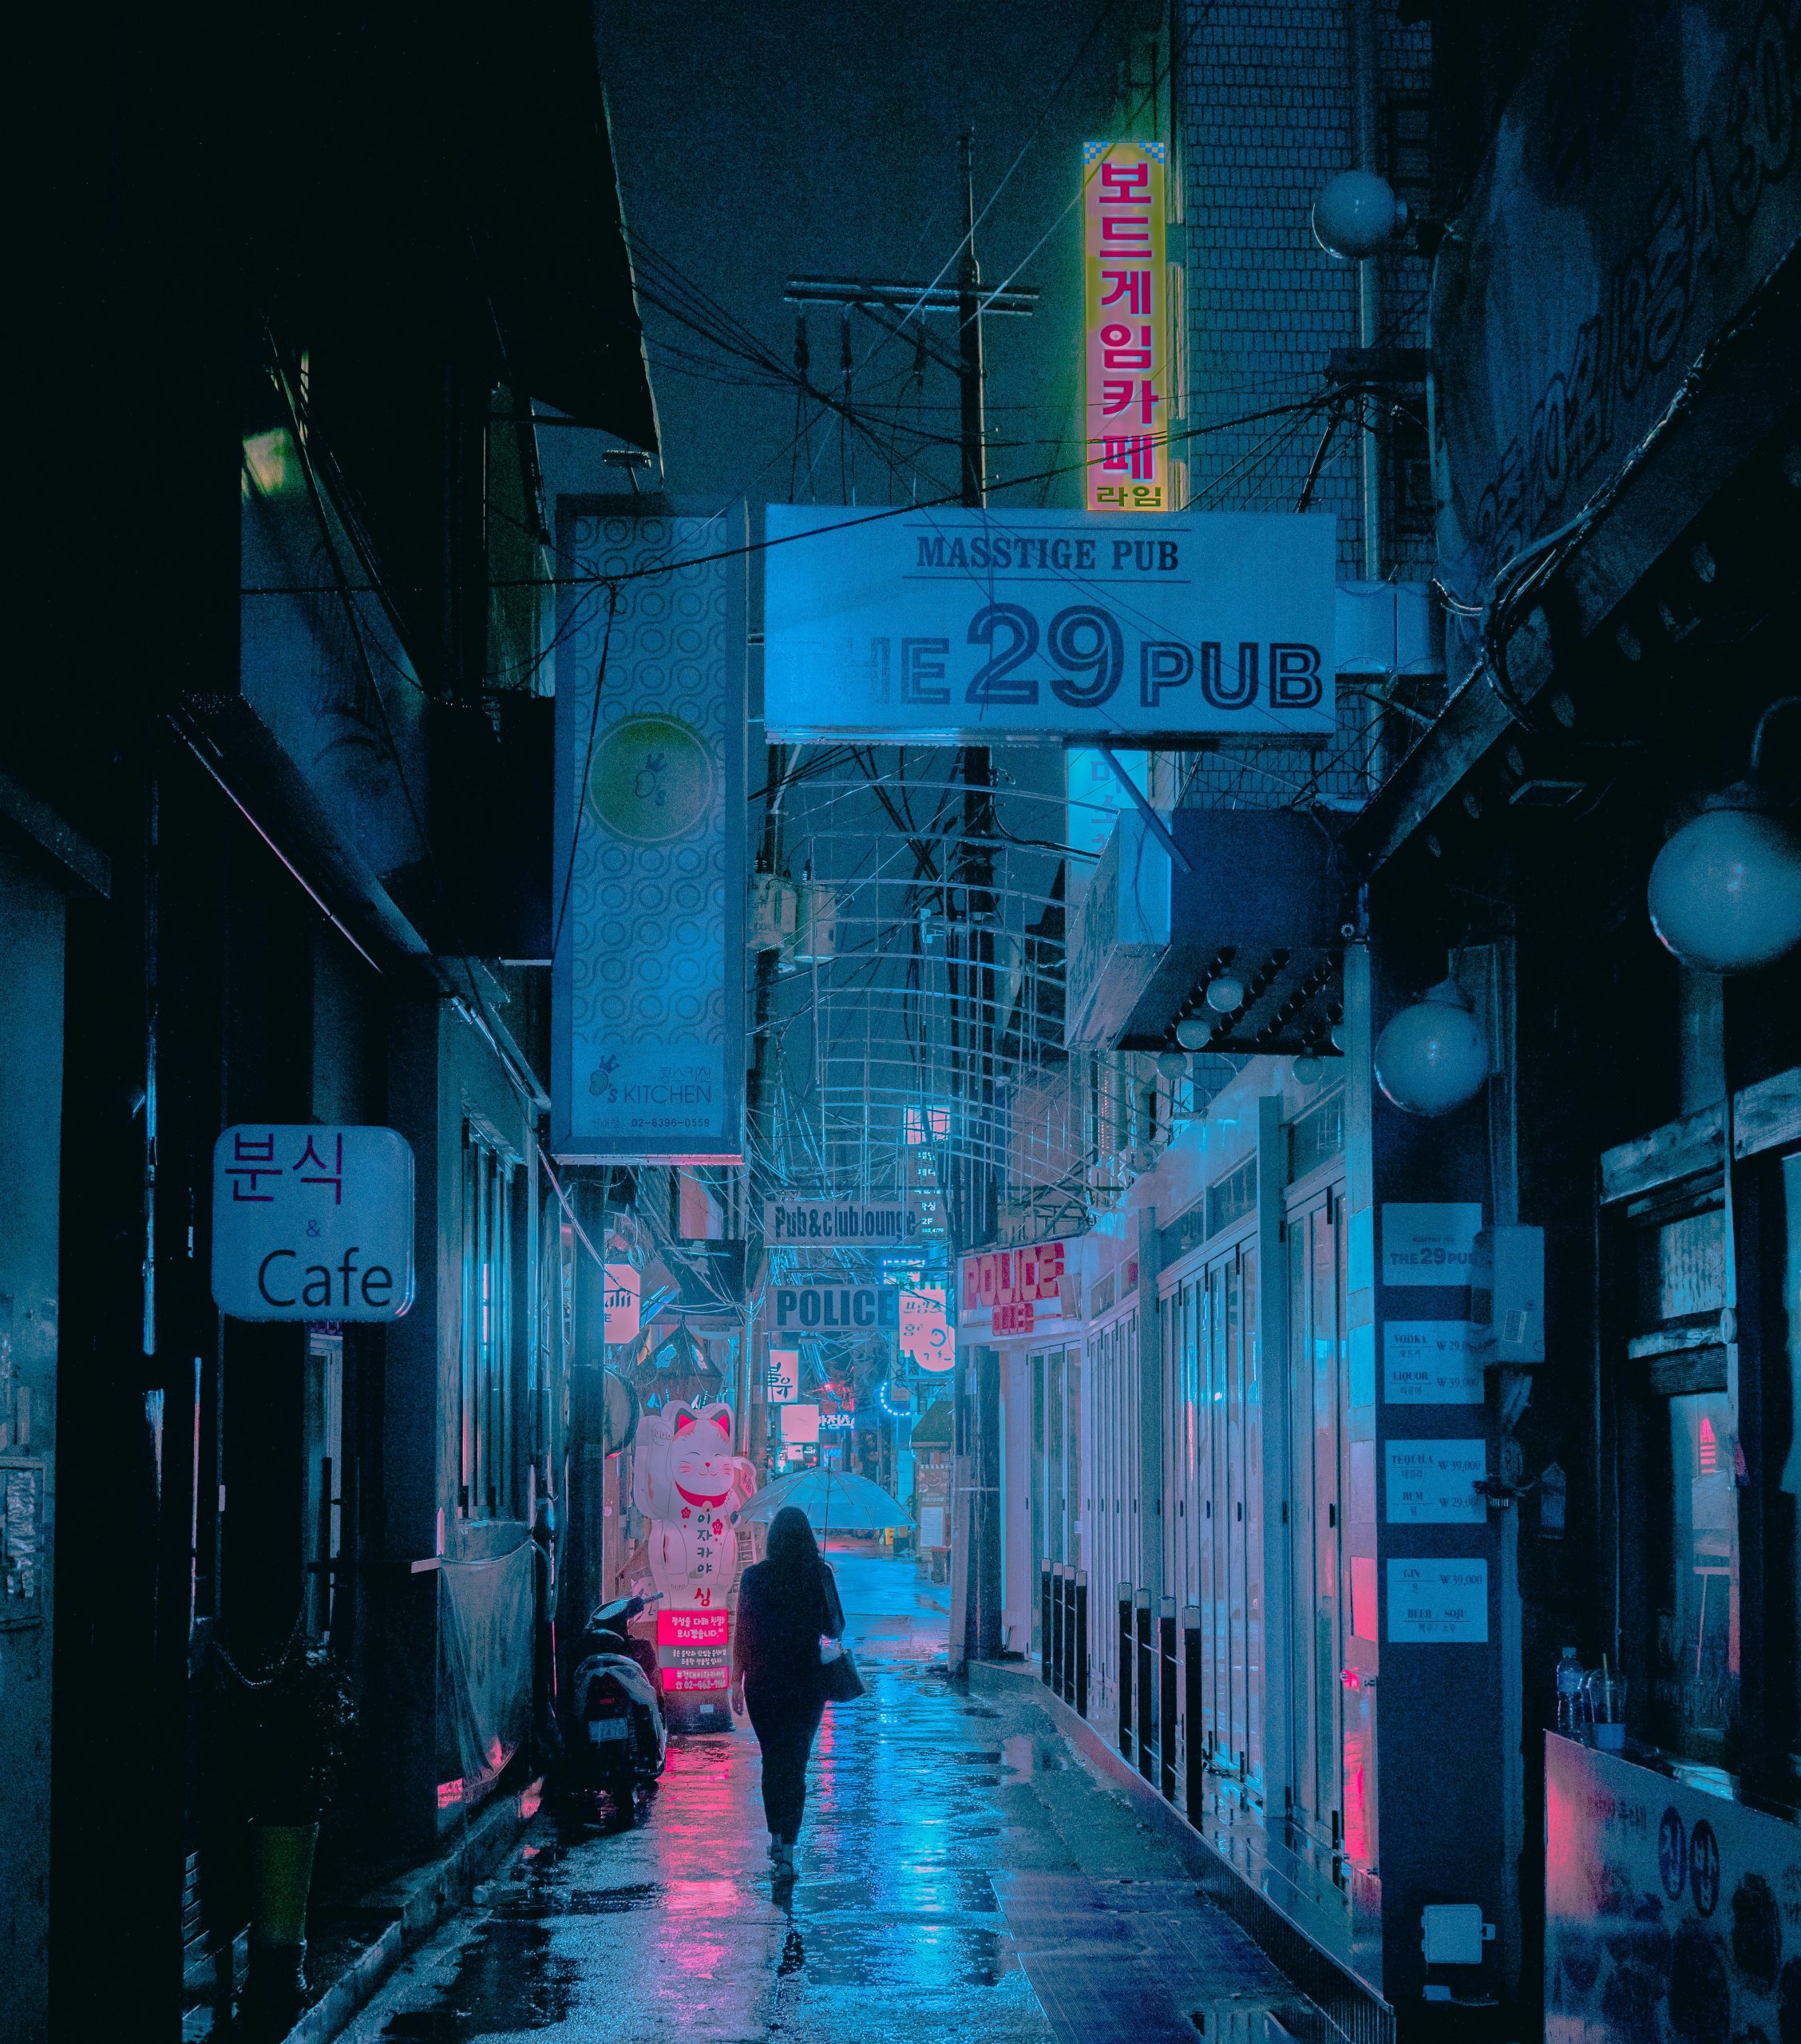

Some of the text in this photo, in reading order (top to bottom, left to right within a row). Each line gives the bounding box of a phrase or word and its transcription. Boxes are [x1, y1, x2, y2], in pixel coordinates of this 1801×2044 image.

[1099, 163, 1158, 480] 보드게임카페
[1097, 485, 1162, 508] 라임
[916, 536, 1180, 572] MASSTIGE PUB
[964, 603, 1125, 709] 29
[1139, 641, 1322, 710] PUB
[624, 1084, 712, 1104] KITCHEN
[631, 1118, 710, 1128] 02-6396-0559
[225, 1132, 342, 1205] 분식
[306, 1219, 320, 1238] &
[1419, 1247, 1446, 1266] 29
[258, 1246, 393, 1307] Cafe
[963, 1242, 1065, 1310] POLICE
[777, 1288, 895, 1327] POLICE
[1392, 1371, 1428, 1383] LIQUOR
[1391, 1455, 1433, 1466] TEQUILA
[696, 1513, 713, 1575] 이자카야
